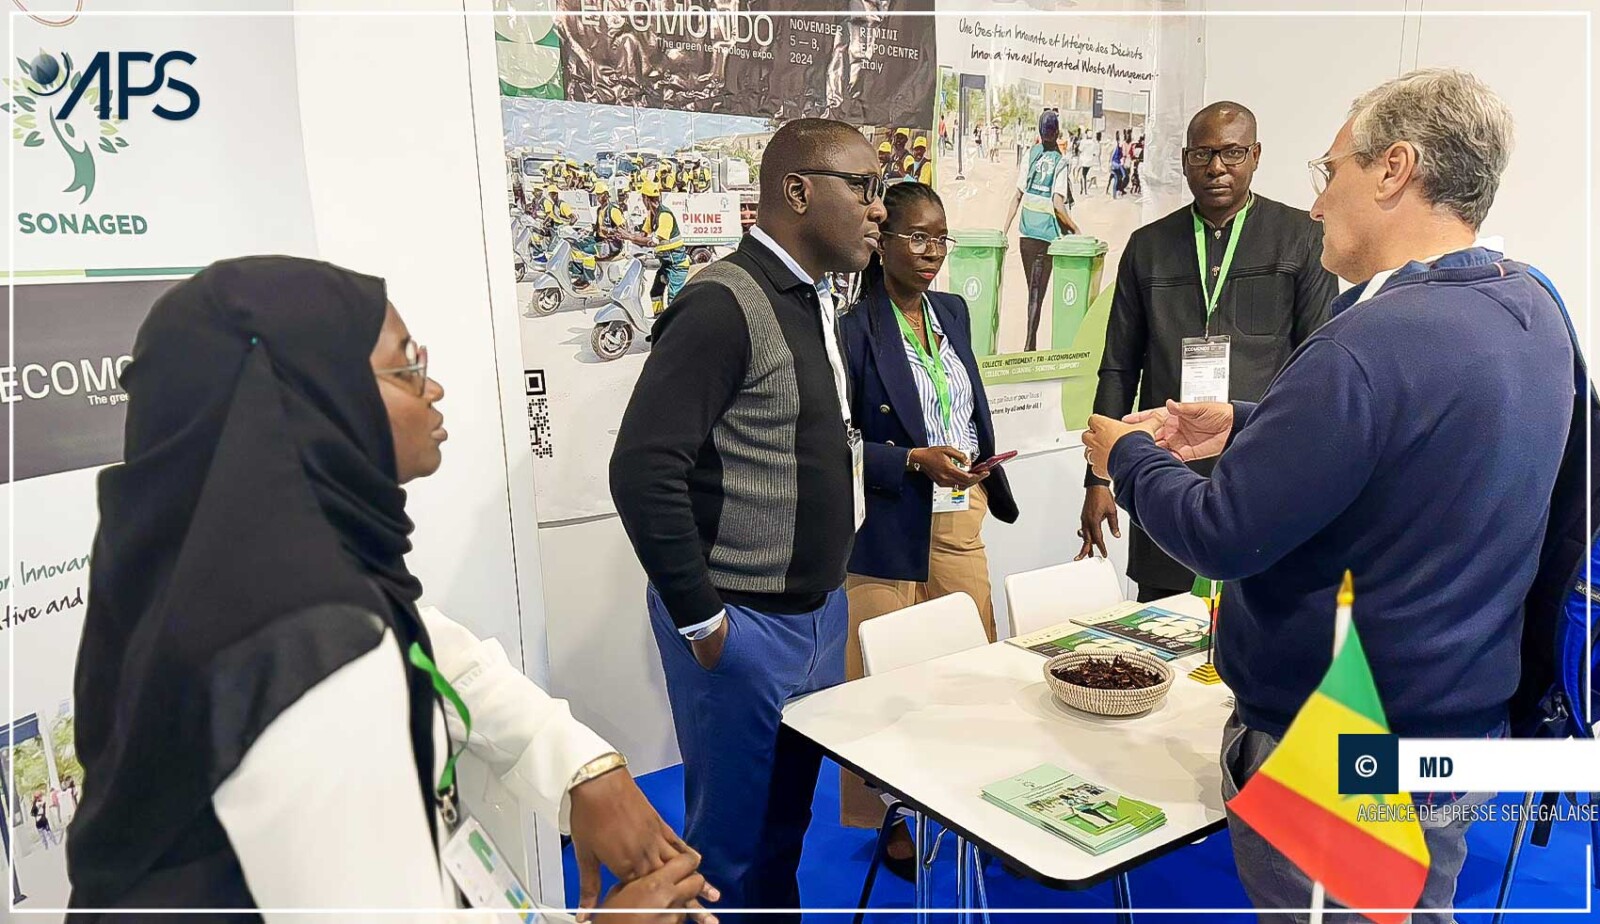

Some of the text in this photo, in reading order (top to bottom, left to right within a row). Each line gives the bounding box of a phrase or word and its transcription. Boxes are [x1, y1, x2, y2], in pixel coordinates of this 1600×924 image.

[789, 18, 843, 36] NOVEMBER
[859, 26, 898, 41] RIMINI
[789, 35, 796, 46] 5
[1048, 33, 1060, 47] et
[1095, 41, 1108, 54] des
[657, 37, 674, 50] The
[675, 40, 702, 53] green
[752, 49, 775, 60] expo.
[887, 46, 919, 60] CENTRE
[789, 52, 814, 65] 2024
[860, 59, 884, 74] Italy
[17, 212, 148, 235] SONAGED
[682, 213, 722, 224] PIKINE
[693, 226, 723, 234] 202 123
[87, 394, 108, 406] The
[0, 587, 83, 631] tive and
